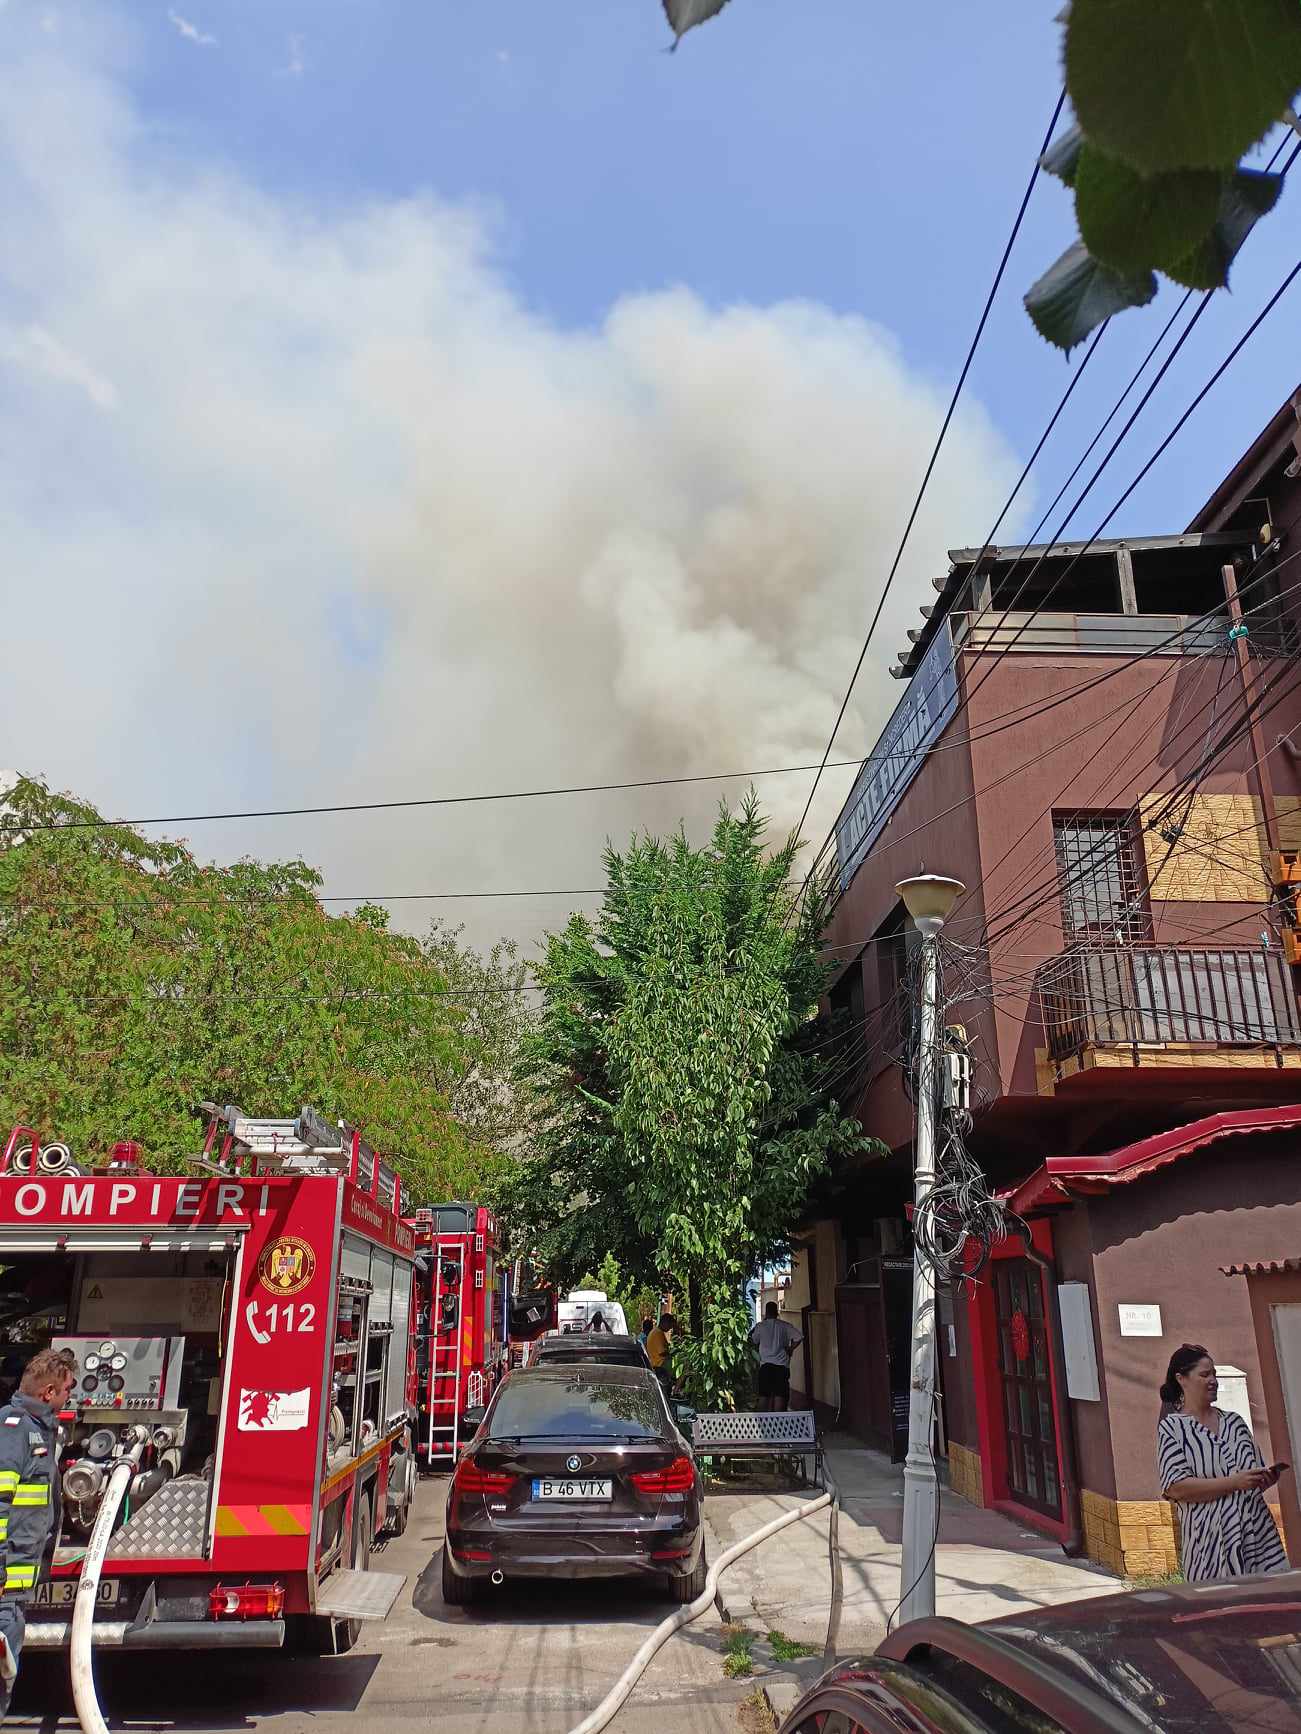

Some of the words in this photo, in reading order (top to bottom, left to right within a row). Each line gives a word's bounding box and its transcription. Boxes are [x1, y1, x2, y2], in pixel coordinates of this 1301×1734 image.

[0, 1182, 270, 1216] OMPIERI
[265, 1303, 316, 1332] 112
[543, 1481, 553, 1496] B
[558, 1481, 574, 1496] 46
[579, 1481, 606, 1496] VTX
